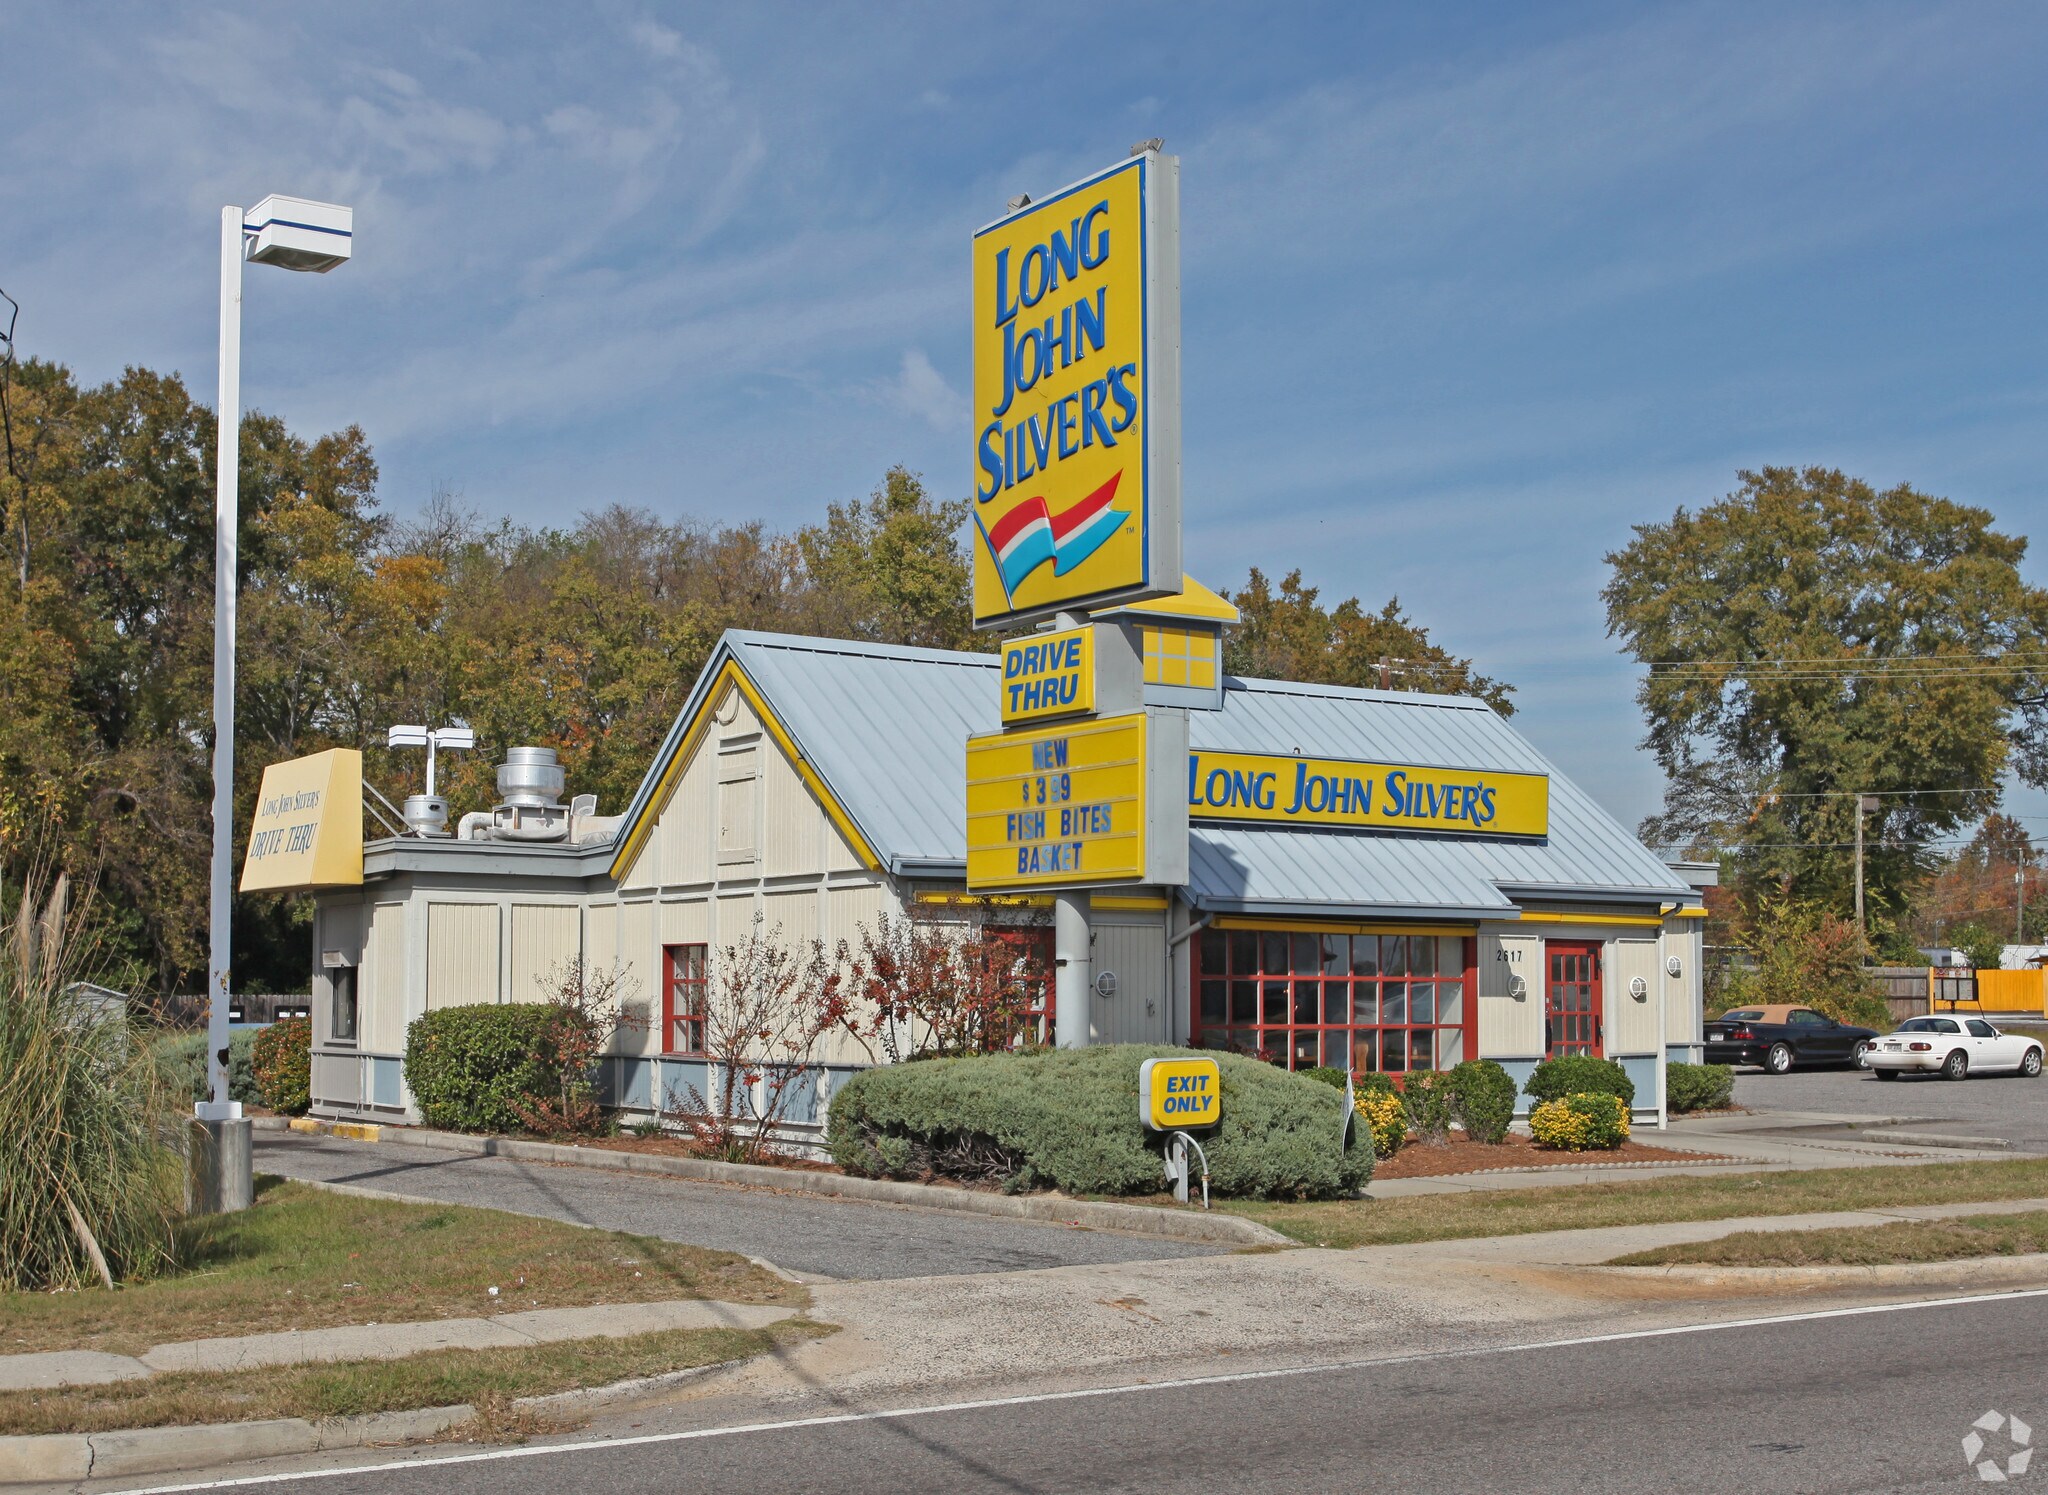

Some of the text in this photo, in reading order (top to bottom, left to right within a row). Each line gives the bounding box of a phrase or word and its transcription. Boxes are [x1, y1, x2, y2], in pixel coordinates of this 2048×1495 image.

[994, 199, 1110, 328] LONG
[992, 284, 1108, 416] JOHN
[977, 362, 1137, 504] SILVER'S
[1005, 637, 1082, 679] DRIVE
[1008, 673, 1079, 713] THRU
[1032, 739, 1068, 769] NEW
[261, 797, 279, 817] LONG
[276, 793, 294, 819] JOHN
[1189, 755, 1497, 827] LONG JOHN SILVER'S
[249, 822, 318, 860] DRIVE THRU
[1007, 803, 1112, 841] FISH BITES
[1018, 842, 1082, 874] BASKET
[1497, 949, 1522, 962] 2617
[1167, 1075, 1209, 1093] EXIT
[1163, 1095, 1213, 1114] ONLY
